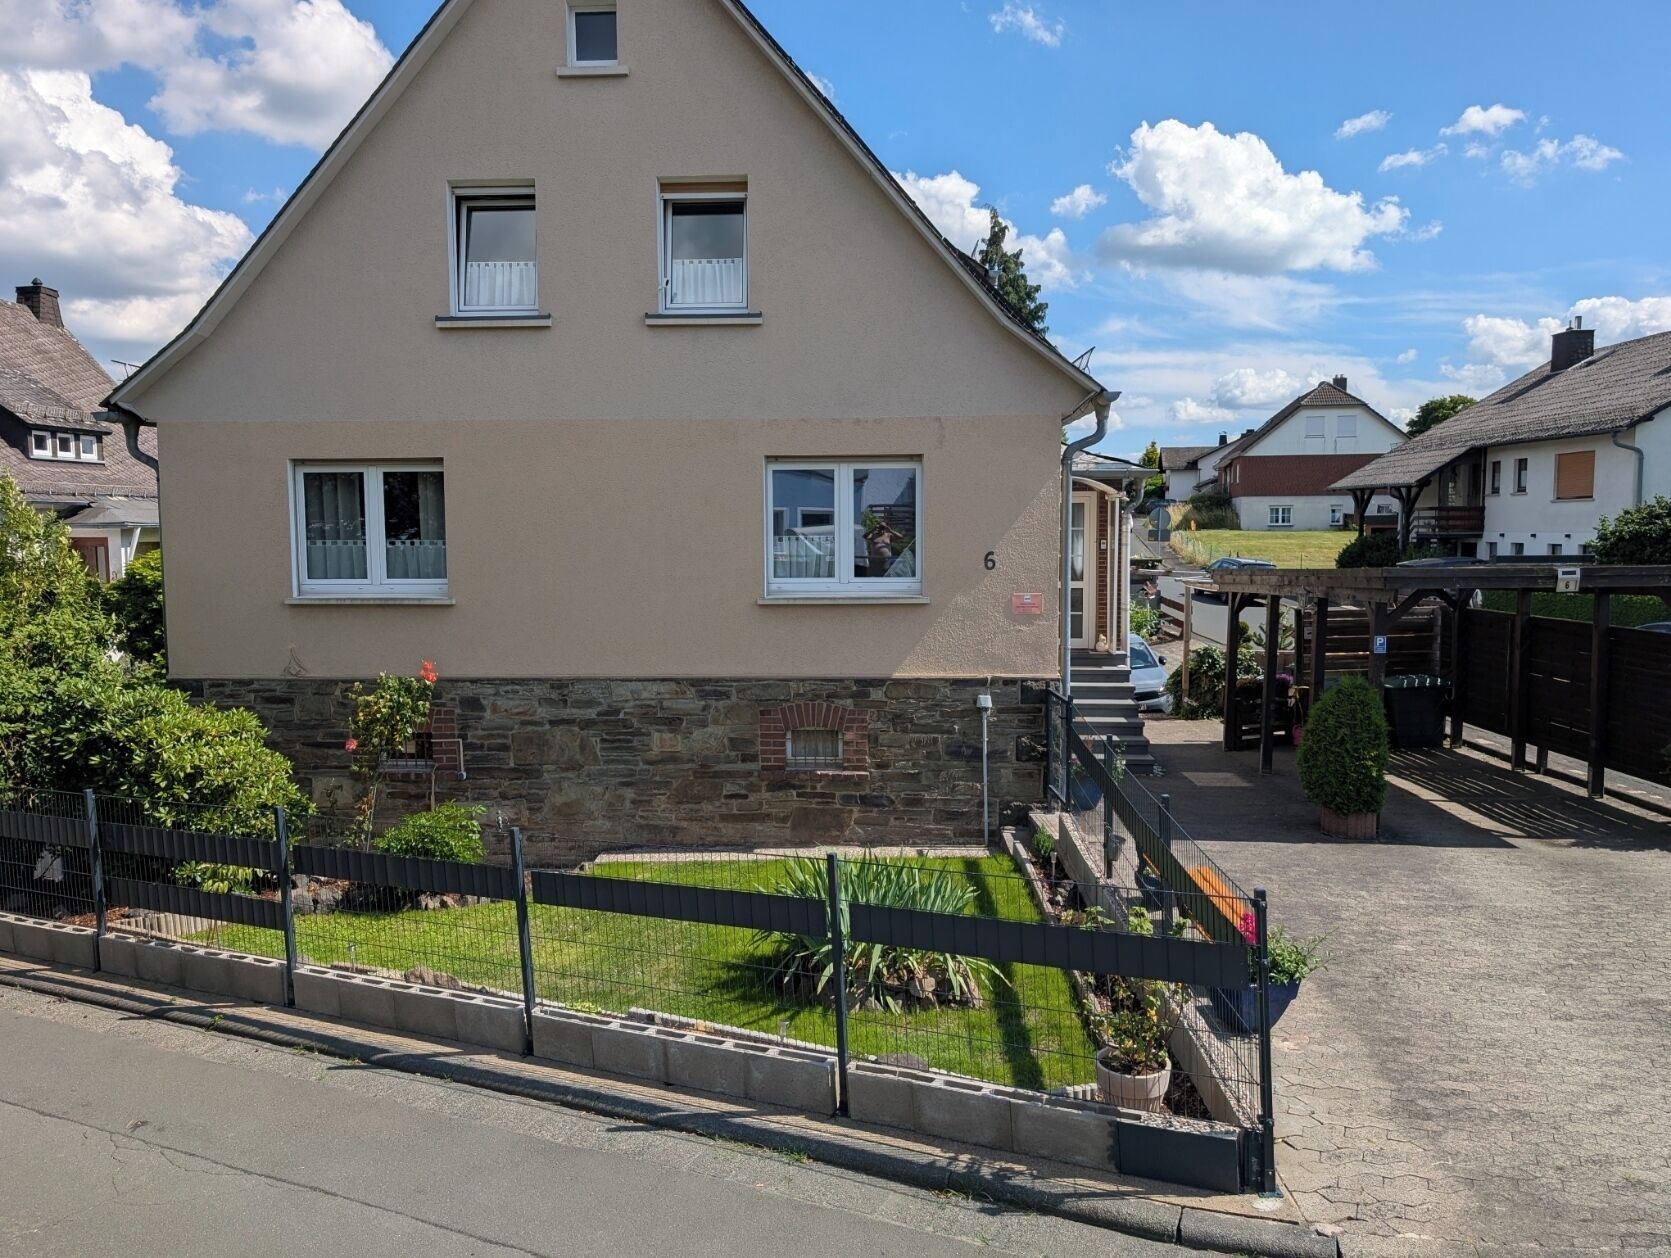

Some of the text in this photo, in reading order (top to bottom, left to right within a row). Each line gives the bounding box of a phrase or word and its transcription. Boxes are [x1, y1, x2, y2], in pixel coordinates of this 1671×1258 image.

[984, 551, 996, 570] 6
[1565, 581, 1570, 589] 6
[1377, 637, 1384, 646] P
